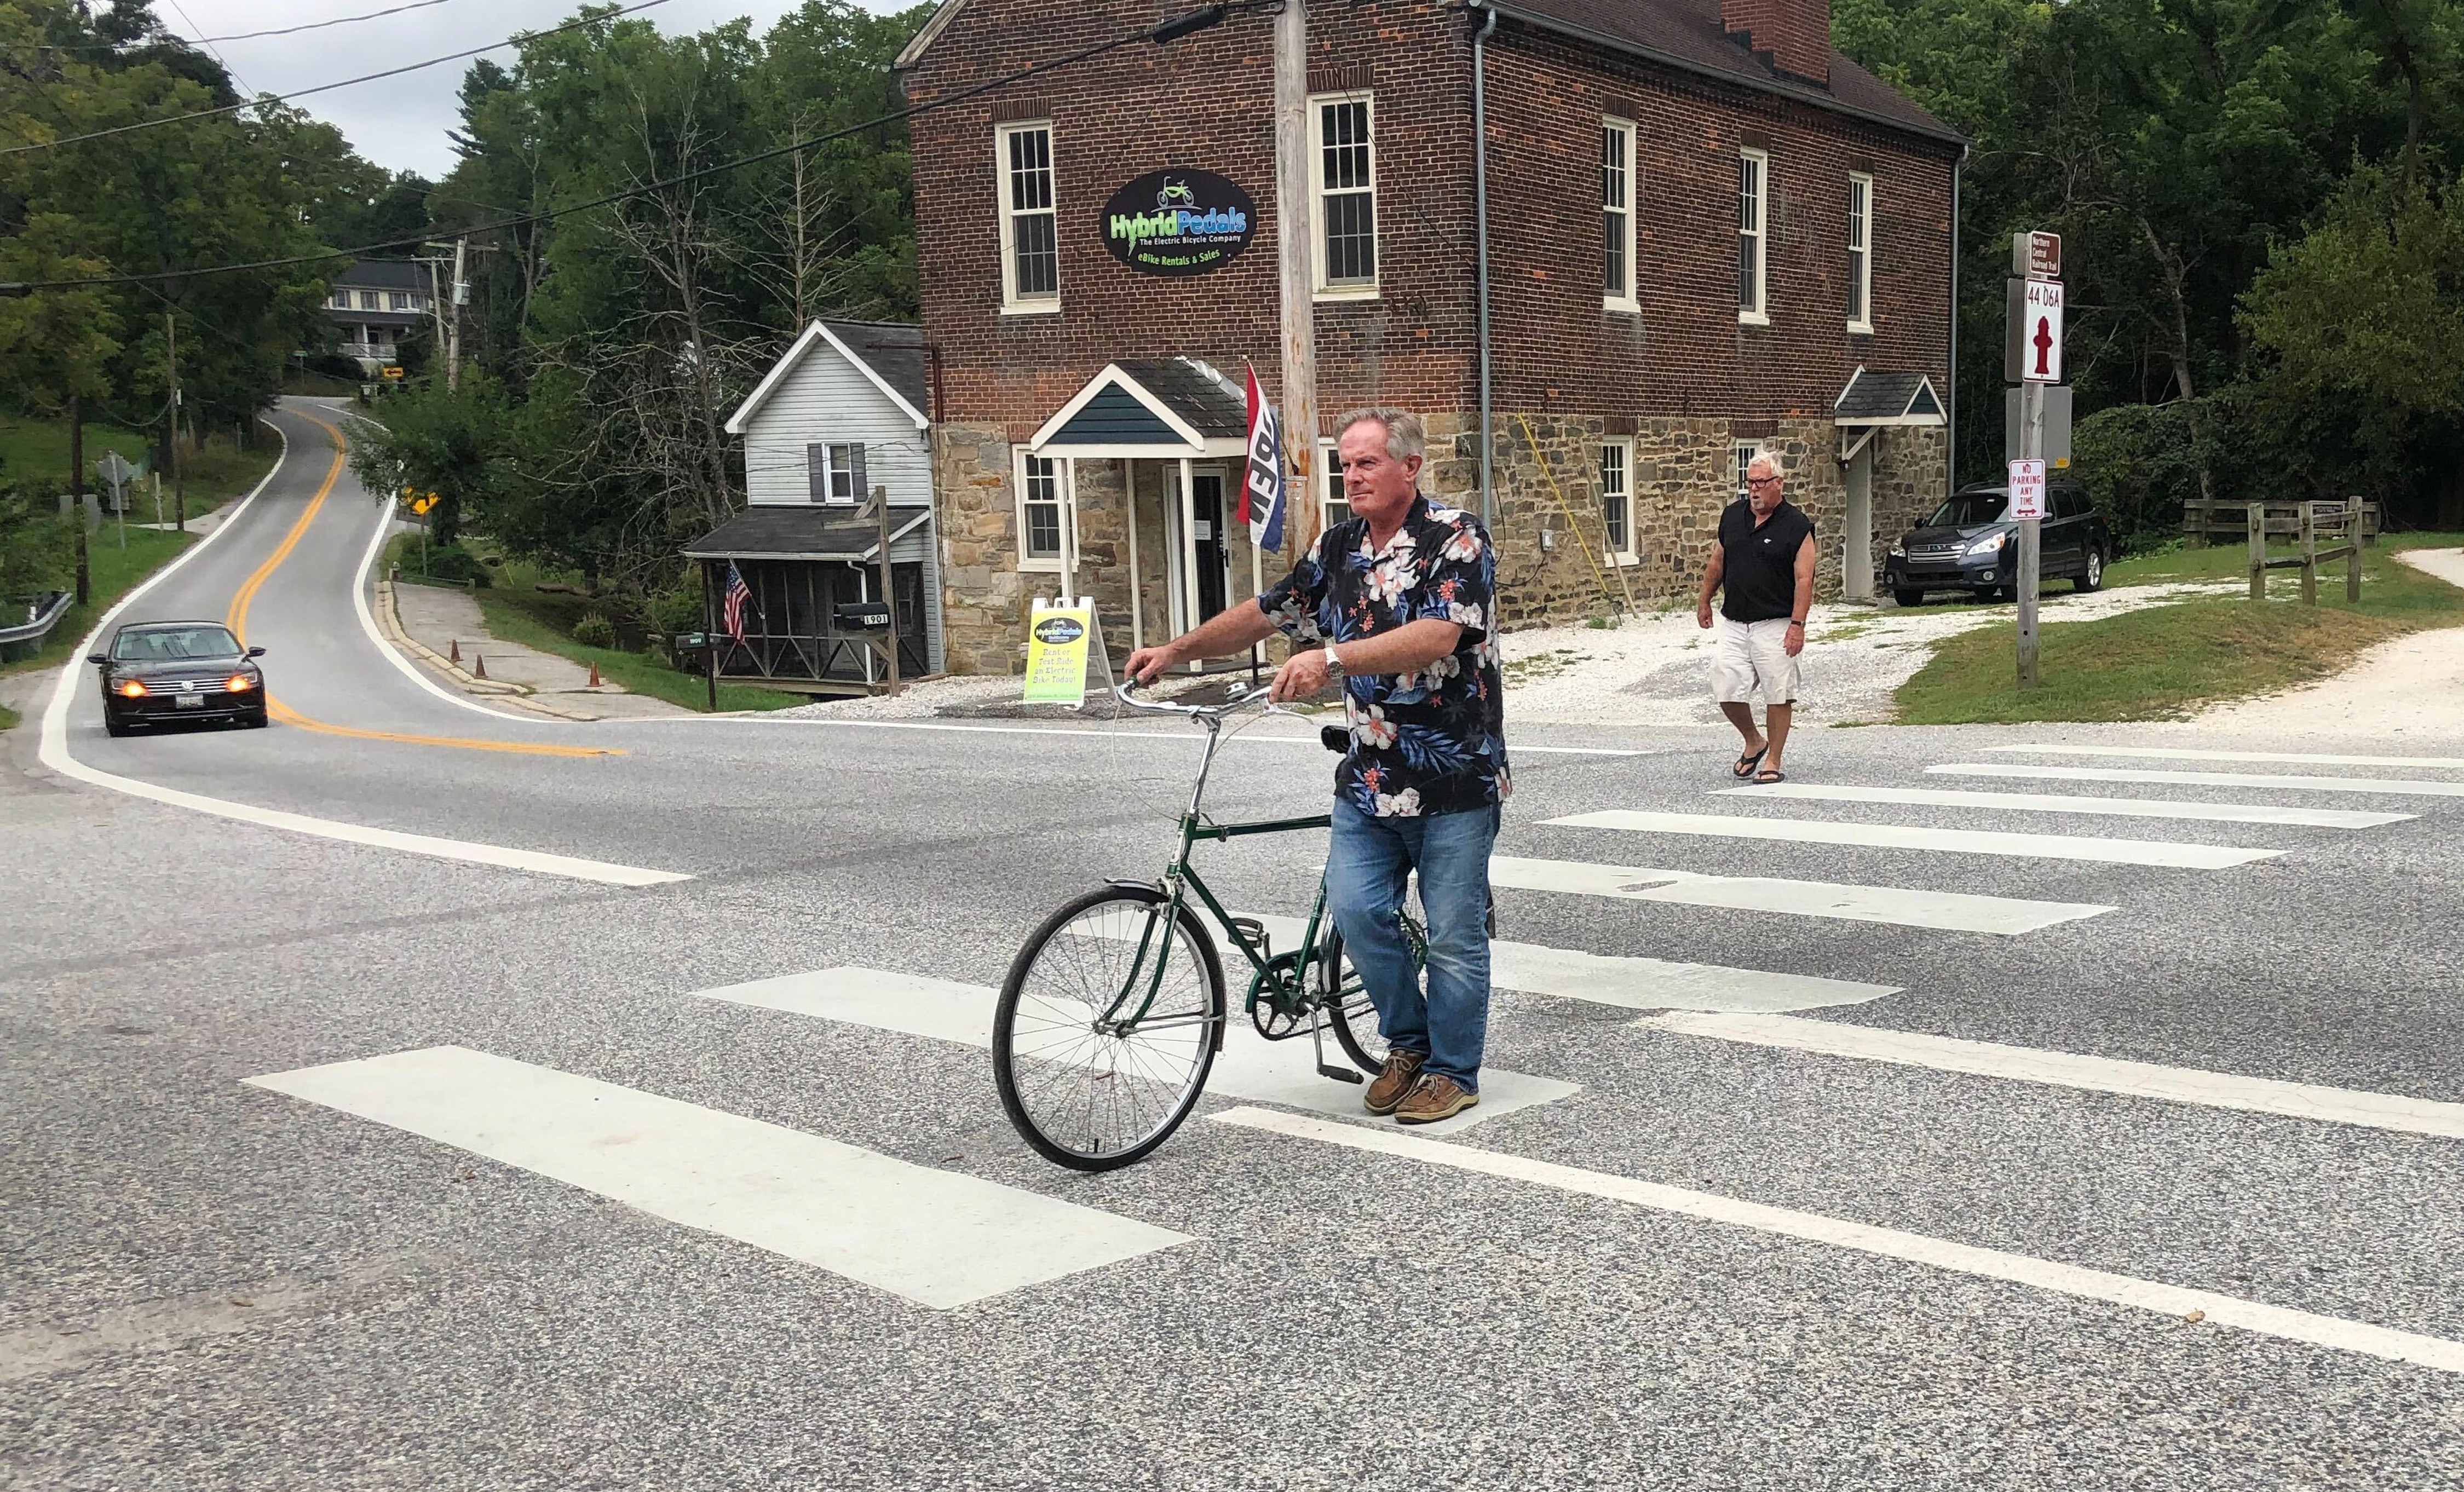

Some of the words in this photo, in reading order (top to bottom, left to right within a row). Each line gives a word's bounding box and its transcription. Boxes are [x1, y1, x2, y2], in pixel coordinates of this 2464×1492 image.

[1183, 236, 1207, 244] Bicycle
[2033, 236, 2050, 247] Northern
[2033, 247, 2047, 258] Central
[1138, 253, 1159, 264] eBike
[1161, 256, 1190, 266] Rentals
[1199, 250, 1220, 262] Sales
[2032, 259, 2047, 269] Railroad
[2028, 286, 2040, 305] 44
[2043, 287, 2059, 308] 06A
[2022, 464, 2031, 474] NO
[2012, 475, 2041, 485] PARKING
[2020, 487, 2033, 496] ANY
[2020, 497, 2033, 505] TIME
[866, 615, 886, 624] 1901
[1052, 675, 1076, 683] Today!
